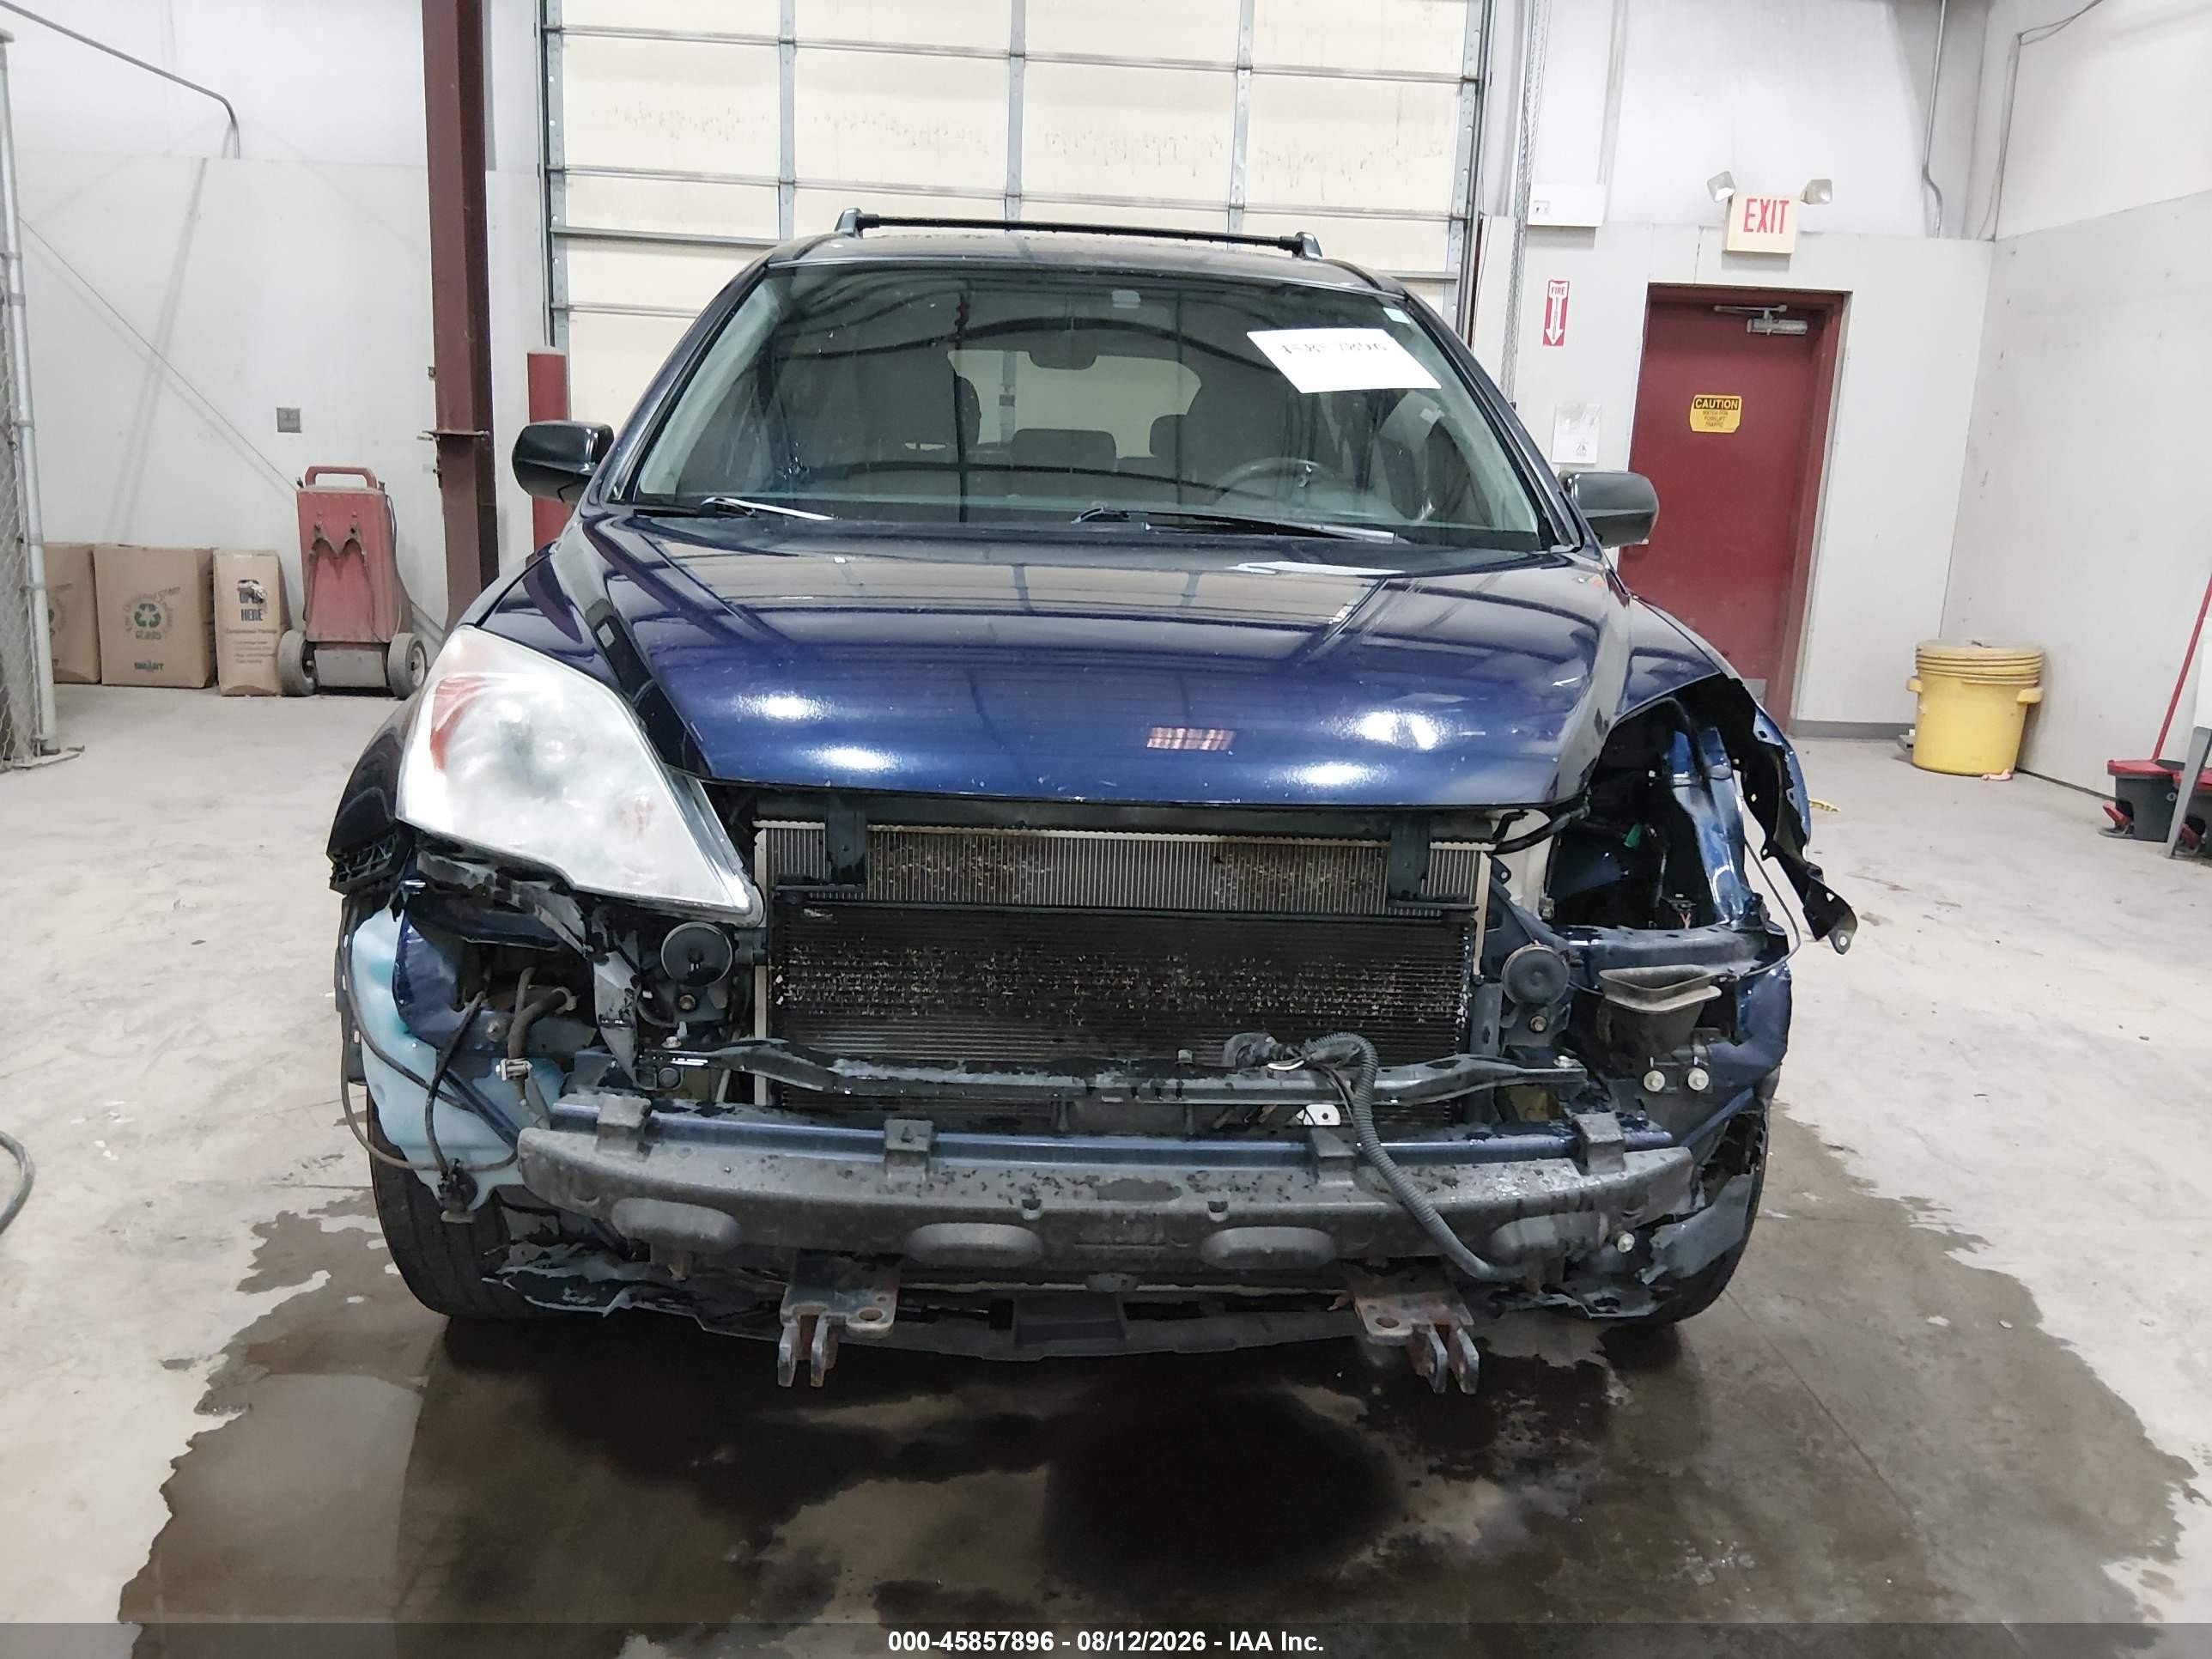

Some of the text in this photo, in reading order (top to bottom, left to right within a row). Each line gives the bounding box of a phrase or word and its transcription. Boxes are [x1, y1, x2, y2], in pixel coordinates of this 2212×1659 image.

[1743, 198, 1790, 234] EXIT
[1551, 286, 1565, 296] FIRE
[1695, 398, 1739, 410] CAUTION
[240, 608, 263, 622] HERE
